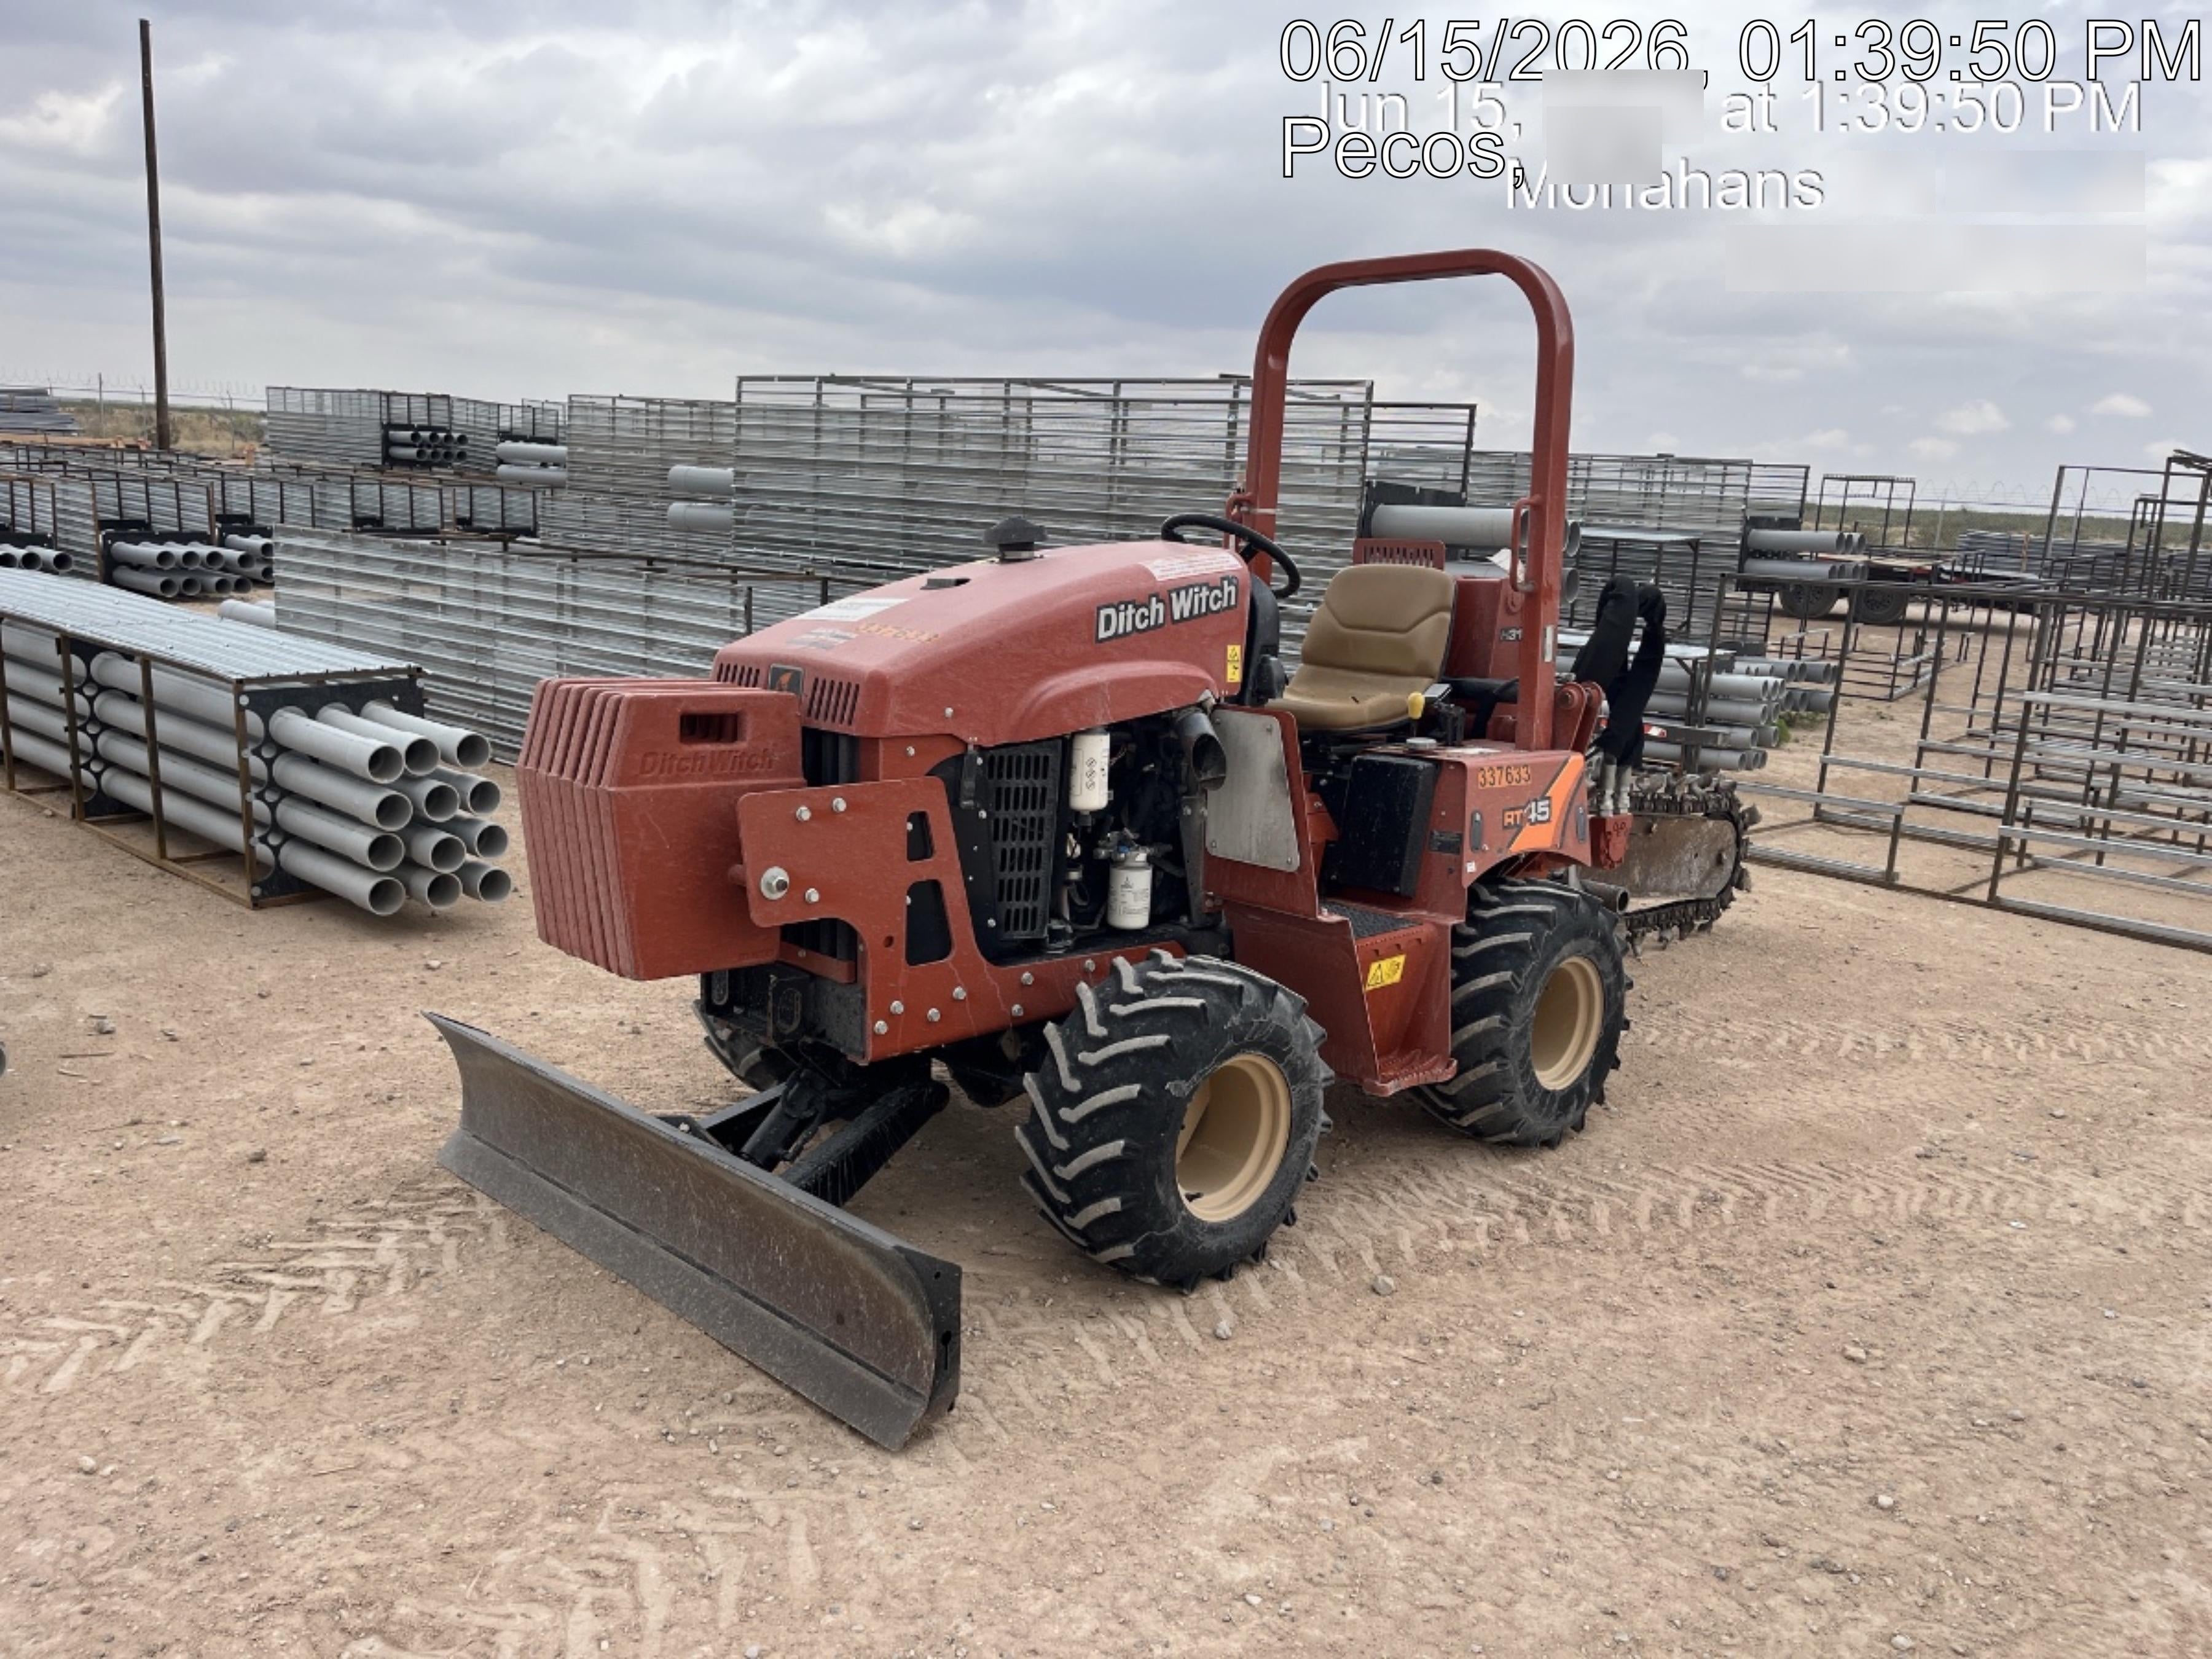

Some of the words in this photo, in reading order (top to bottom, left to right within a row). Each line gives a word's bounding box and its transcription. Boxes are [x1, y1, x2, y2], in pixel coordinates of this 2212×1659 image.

[1097, 596, 1165, 641] Ditch
[1170, 579, 1237, 621] Witch
[639, 751, 706, 776] Ditch
[708, 747, 774, 774] Witch
[1478, 764, 1531, 788] 337633
